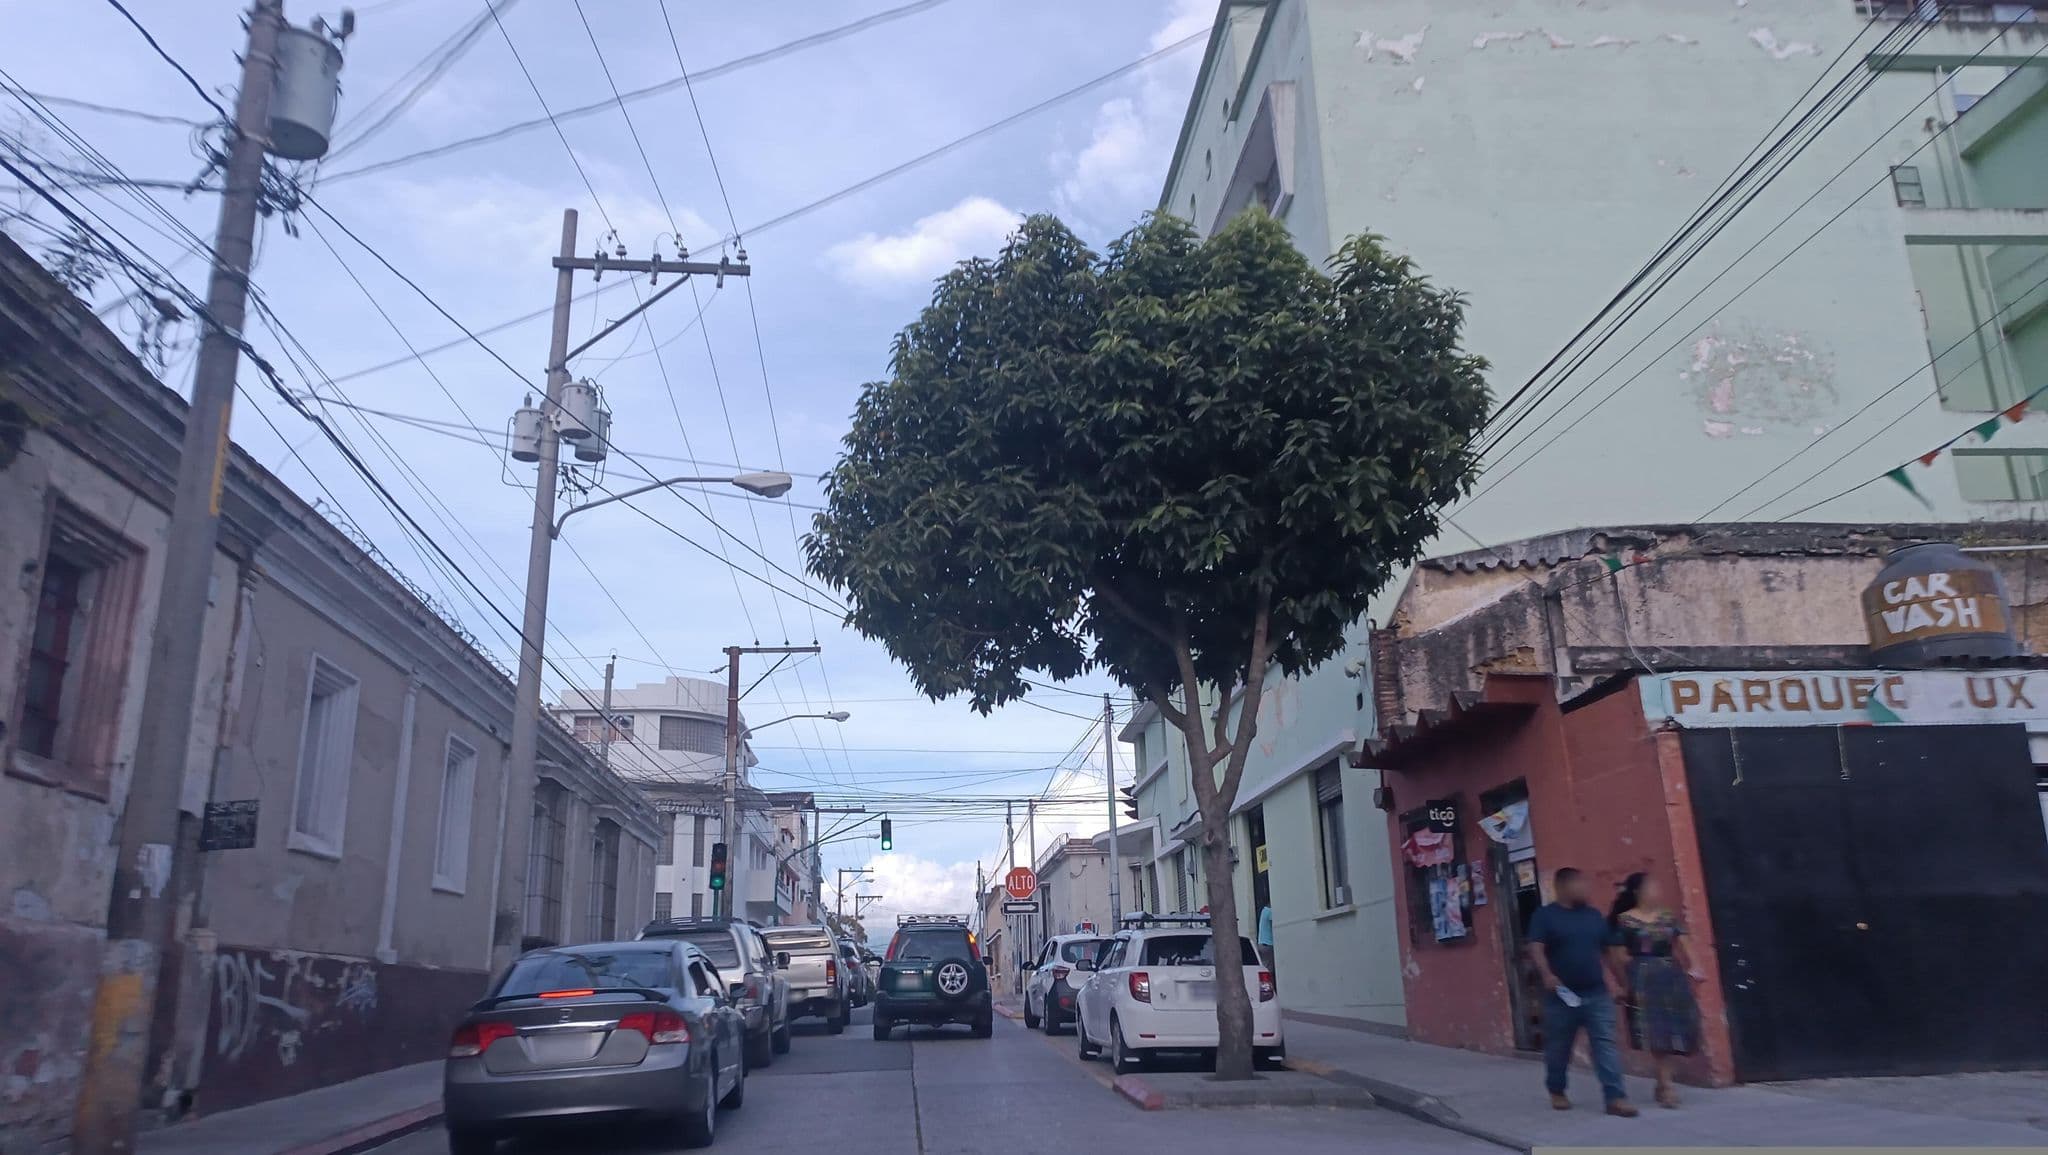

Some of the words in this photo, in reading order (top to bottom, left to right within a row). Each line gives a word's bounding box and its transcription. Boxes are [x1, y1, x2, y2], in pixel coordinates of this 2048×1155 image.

[1883, 572, 1958, 604] CAR
[1881, 597, 1982, 634] WASH
[1952, 676, 2035, 709] UX
[1429, 806, 1455, 827] tigo
[1008, 875, 1033, 890] ALTO
